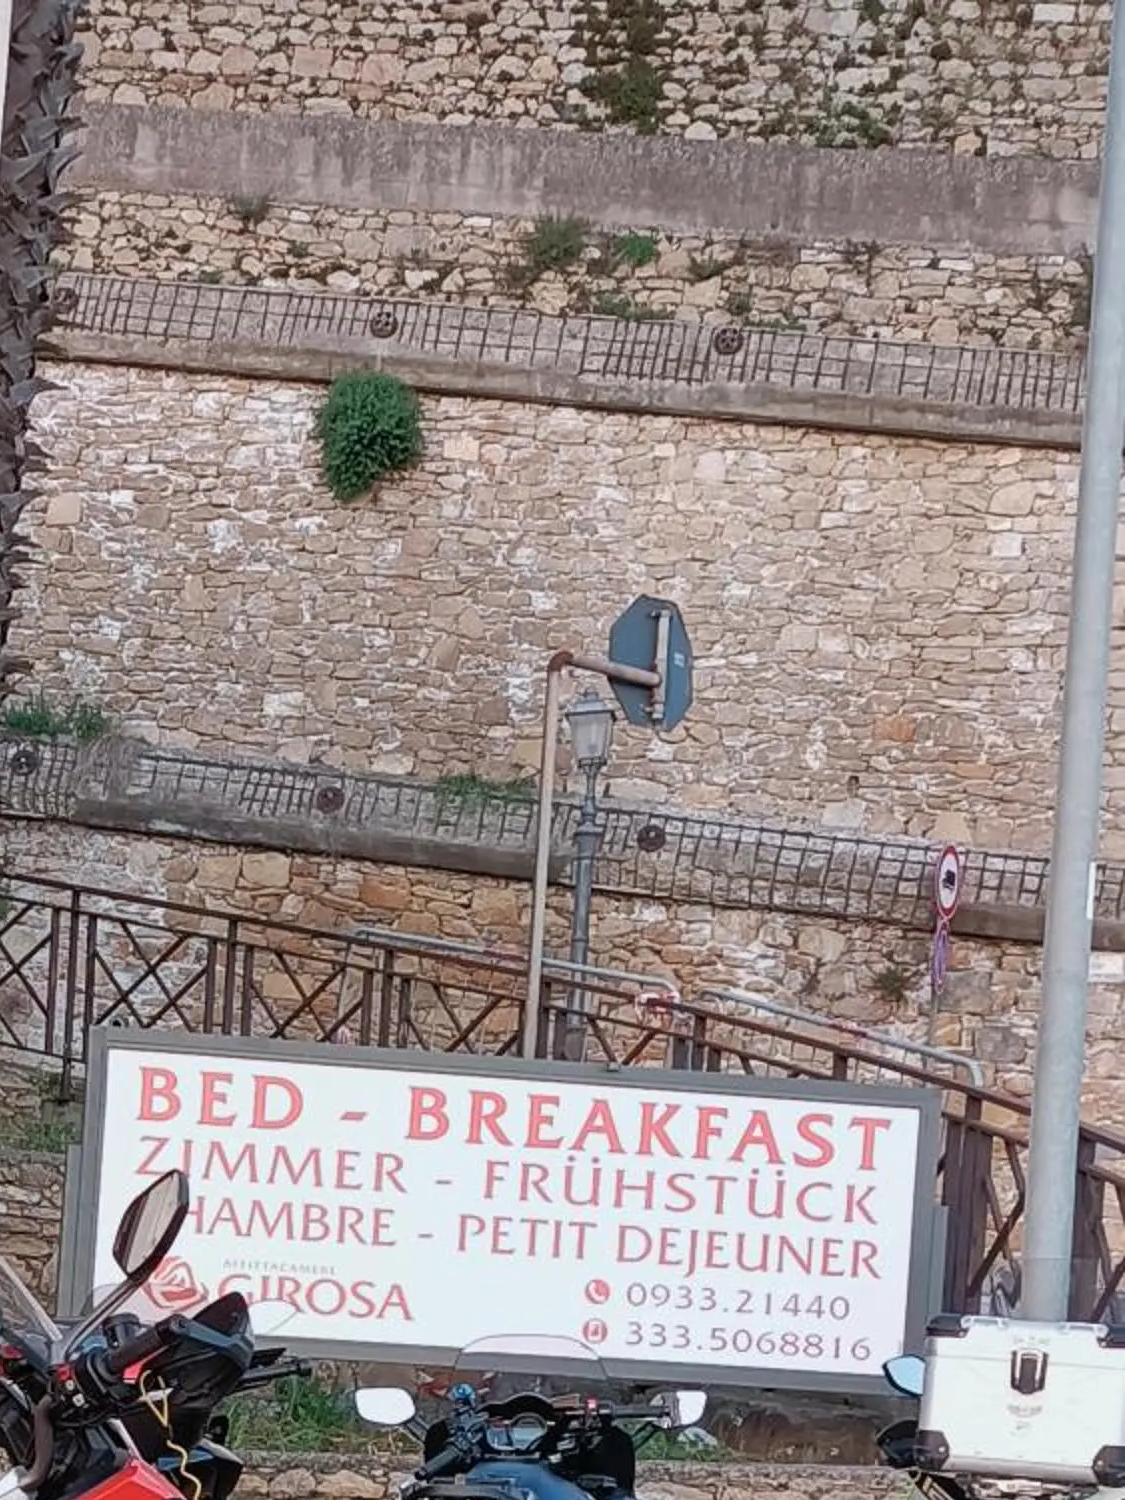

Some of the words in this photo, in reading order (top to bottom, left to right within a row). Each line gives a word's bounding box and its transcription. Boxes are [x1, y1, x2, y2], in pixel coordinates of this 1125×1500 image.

[137, 1066, 304, 1130] BED
[405, 1086, 892, 1171] BREAKFAST
[135, 1135, 407, 1194] ZIMMER
[483, 1155, 878, 1225] FRÜHSTÜCK
[187, 1196, 397, 1247] HAMBRE
[457, 1214, 598, 1260] PETIT
[616, 1224, 882, 1280] DEJEUNER
[218, 1274, 415, 1322] GIROSA
[626, 1282, 851, 1321] 0933.21440
[625, 1322, 871, 1362] 333.5068816
